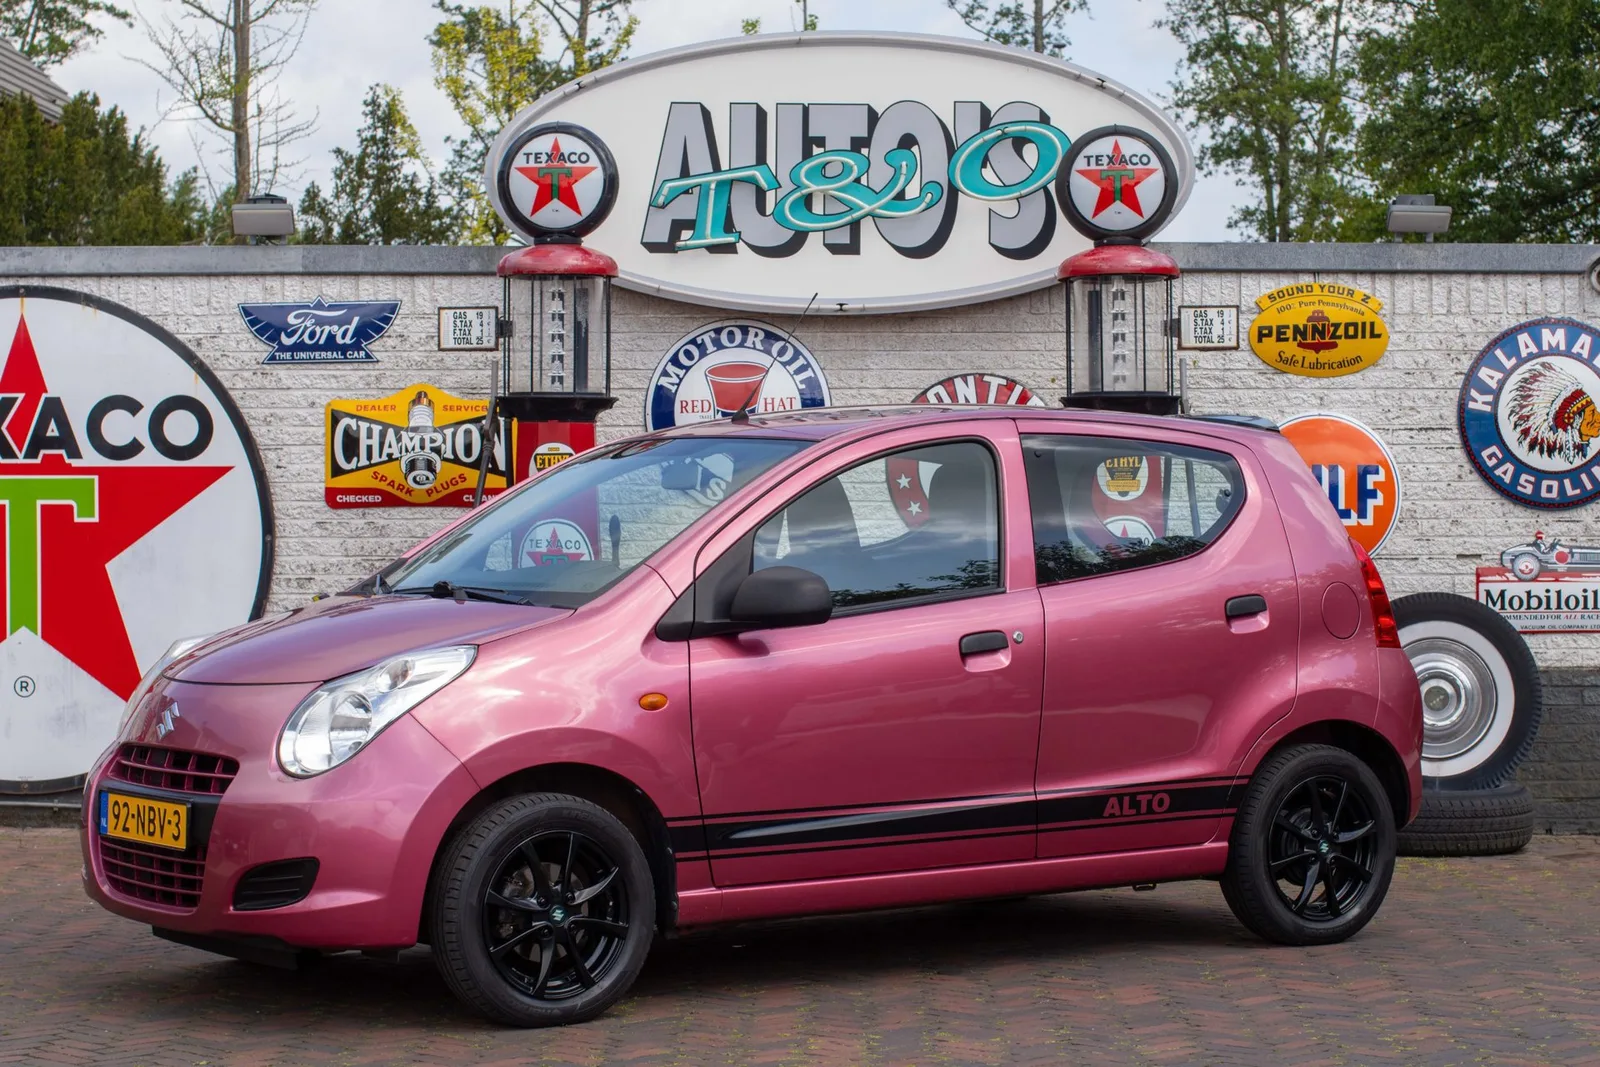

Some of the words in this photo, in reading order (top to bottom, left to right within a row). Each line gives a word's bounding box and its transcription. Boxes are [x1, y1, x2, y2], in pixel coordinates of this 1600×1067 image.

[523, 152, 590, 164] TEXACO
[1084, 154, 1151, 167] TEXACO
[641, 100, 1057, 259] AUTO'S
[1267, 284, 1314, 303] SOUND
[1319, 284, 1355, 298] YOUR
[1361, 294, 1371, 304] Z
[1193, 310, 1208, 318] GAS
[1217, 310, 1224, 318] 19
[1299, 300, 1316, 308] Pure
[1318, 299, 1365, 316] Pennsylvania
[453, 311, 467, 320] GAS
[476, 311, 483, 320] 19
[1193, 318, 1214, 327] S.TAX
[280, 309, 360, 346] Ford
[453, 320, 472, 328] S.TAX
[1193, 327, 1213, 335] F.TAX
[453, 329, 472, 337] F.TAX
[1257, 321, 1382, 343] PENNZOIL
[453, 337, 474, 345] TOTAL
[476, 337, 484, 345] 25
[1194, 336, 1215, 344] TOTAL
[1217, 336, 1225, 344] 25
[275, 352, 292, 360] THE
[294, 351, 344, 360] UNIVERSAL
[347, 351, 366, 359] CAR
[657, 327, 766, 393] MOTOR
[771, 340, 815, 389] OIL
[1275, 350, 1299, 368] Safe
[1301, 355, 1363, 370] Lubrication
[1467, 328, 1600, 412] KALAMA
[926, 375, 1046, 405] ONTI
[356, 404, 397, 412] DEALER
[680, 399, 712, 414] RED
[763, 397, 797, 412] HAT
[1481, 445, 1600, 500] GASOLI
[371, 471, 414, 497] SPARK
[426, 473, 467, 497] PLUGS
[336, 494, 382, 503] CHECKED
[529, 538, 581, 551] TEXACO
[1484, 588, 1600, 611] Mobiloil
[1103, 793, 1171, 817] ALTO
[101, 818, 107, 828] NL
[112, 800, 181, 841] 92-NBV-3
